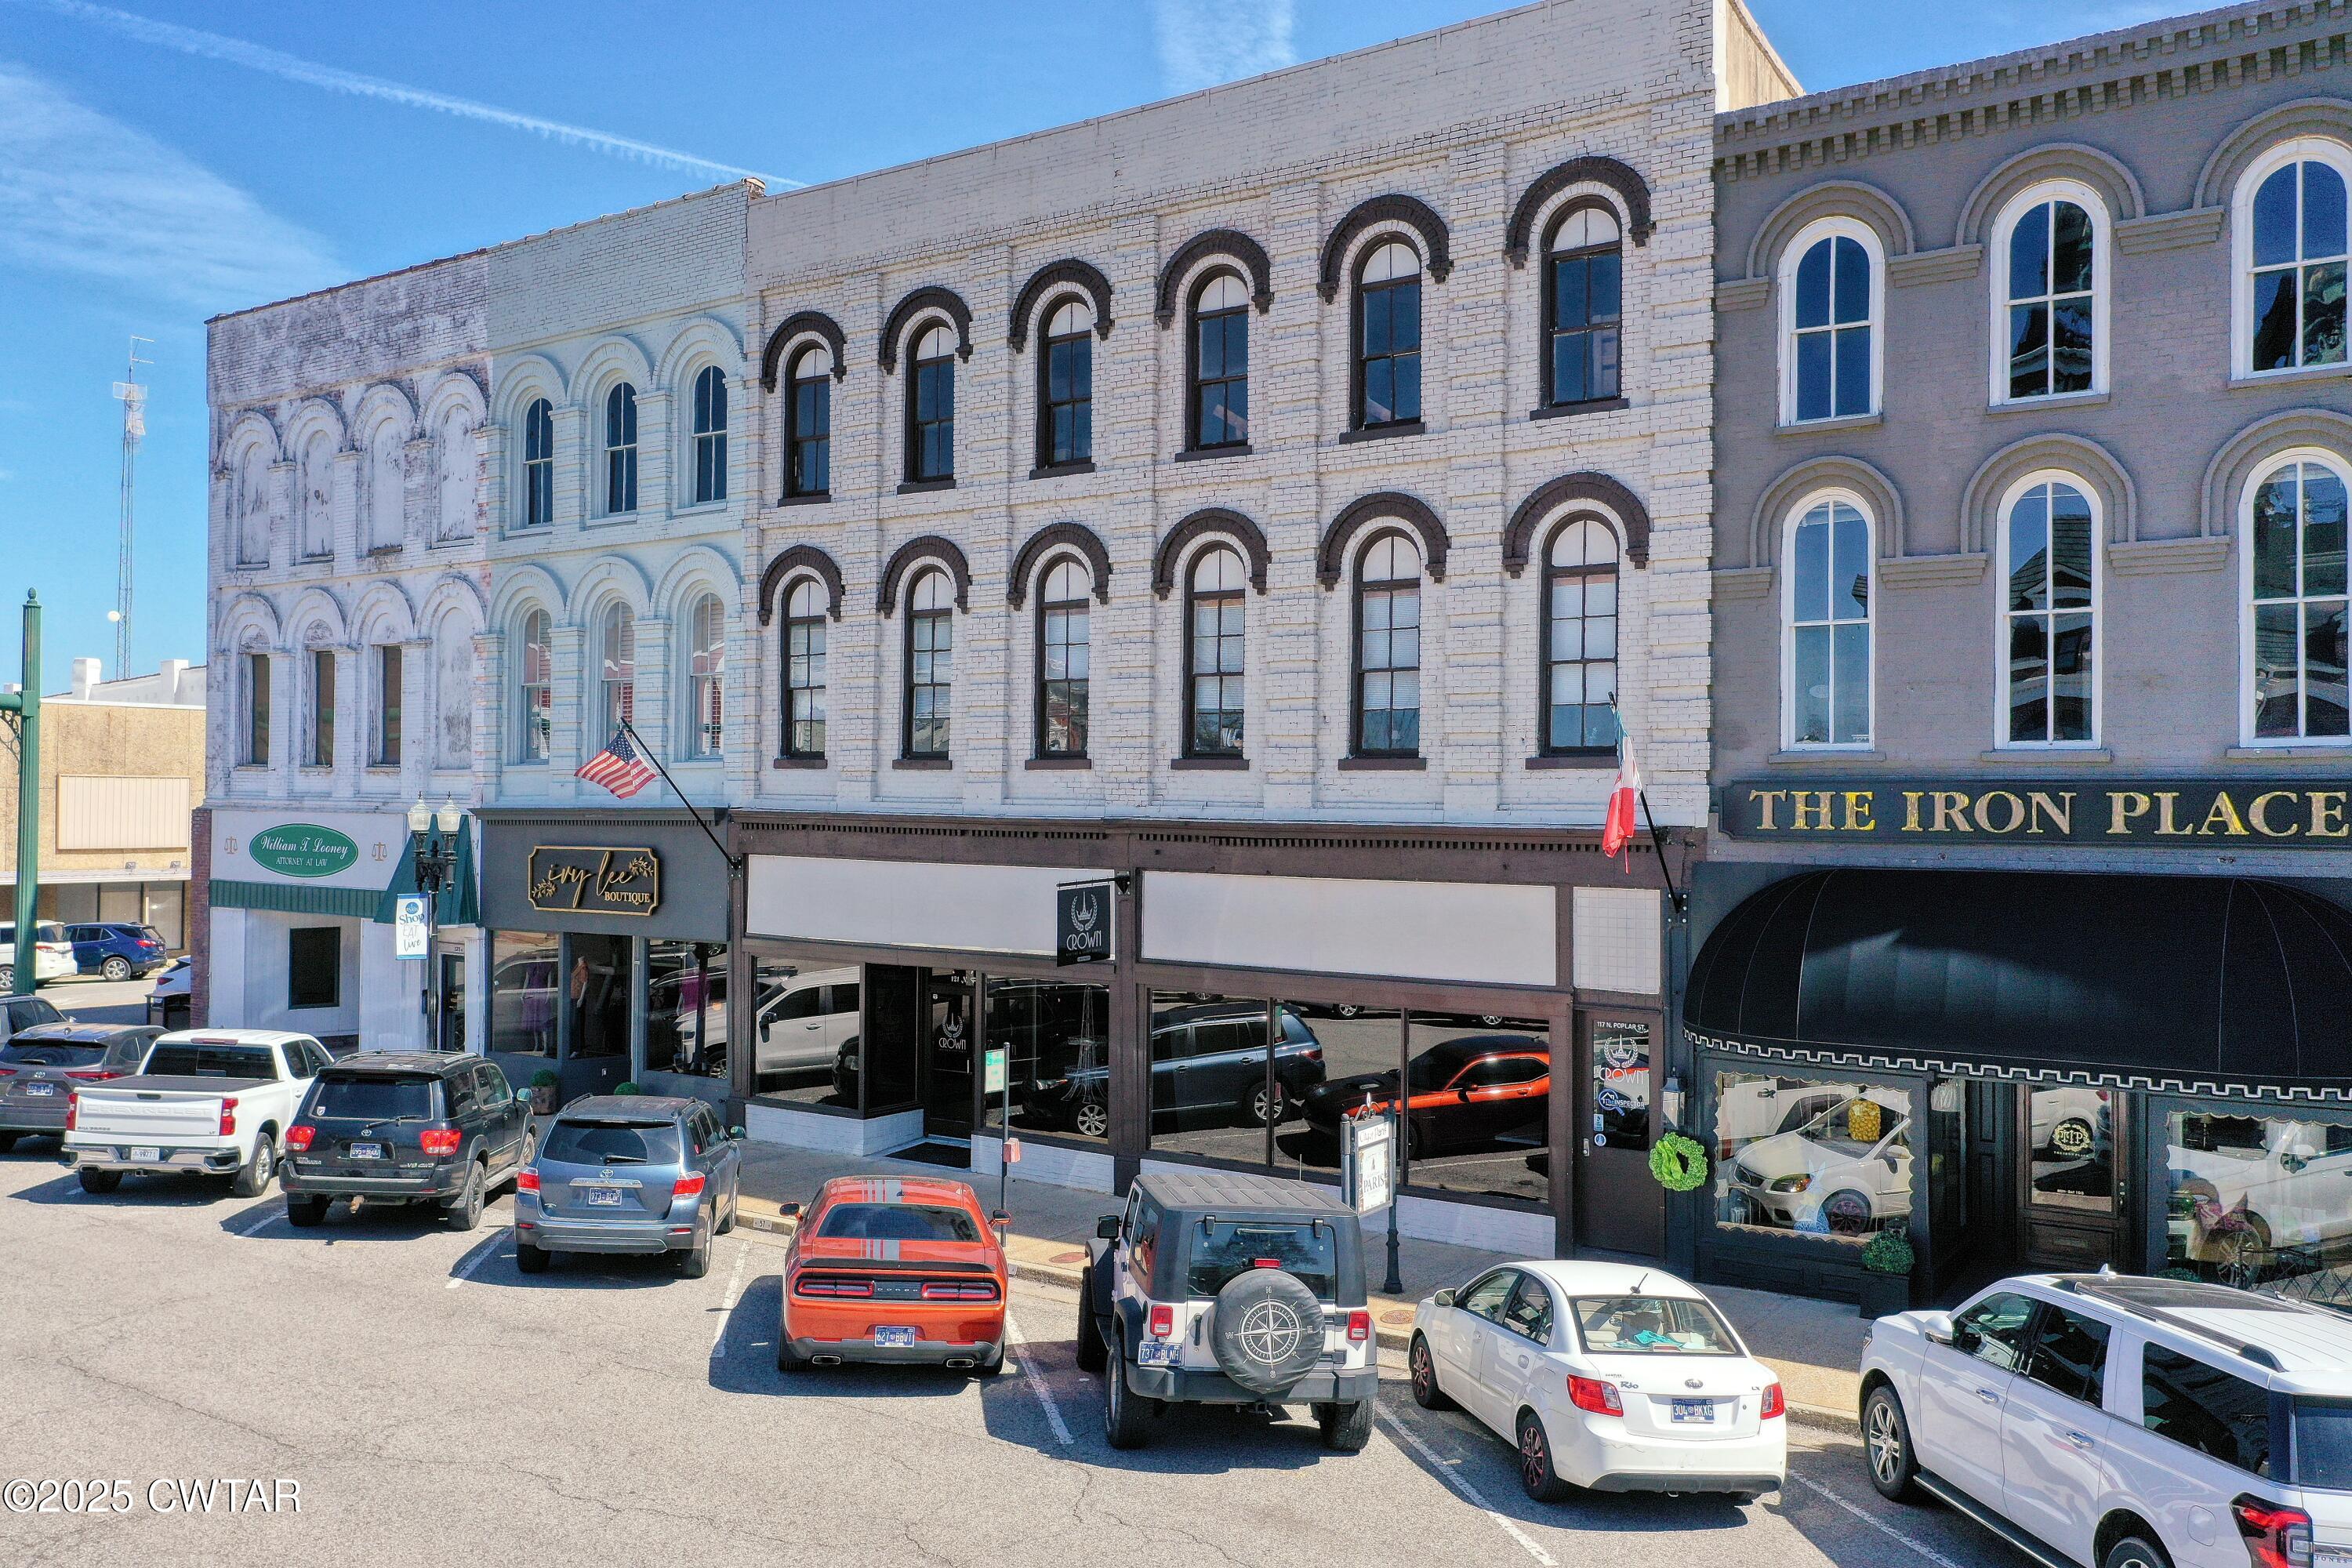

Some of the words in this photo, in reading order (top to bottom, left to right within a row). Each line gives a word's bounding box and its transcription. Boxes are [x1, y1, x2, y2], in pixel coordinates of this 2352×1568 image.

[1749, 789, 1875, 831] THE
[1900, 790, 2078, 835] IRON
[2105, 790, 2350, 837] PLACE
[260, 835, 297, 851] William
[299, 837, 310, 852] T.
[312, 837, 349, 860] Looney
[276, 856, 303, 866] ATTORNEY
[306, 858, 314, 866] AT
[315, 858, 328, 867] LAW
[596, 851, 633, 897] lee
[604, 891, 652, 906] BOUTIQUE
[398, 913, 425, 925] Shop
[402, 924, 418, 939] EAT
[1066, 930, 1102, 951] CROWN
[938, 1037, 967, 1051] CROWN
[1599, 1067, 1645, 1085] CROWN
[85, 1103, 212, 1117] CHEVROLET
[1615, 1099, 1646, 1109] INSPECTOR
[1363, 1173, 1385, 1192] PARIS
[590, 1192, 601, 1200] 973
[1225, 1331, 1234, 1340] W
[1307, 1325, 1313, 1334] E
[877, 1331, 890, 1342] 627
[1141, 1348, 1155, 1360] 737
[1160, 1348, 1179, 1361] BLNH
[1620, 1381, 1639, 1389] Rio
[1673, 1404, 1688, 1416] 304
[1693, 1404, 1713, 1417] BKXG
[2314, 1555, 2348, 1564] JONES
